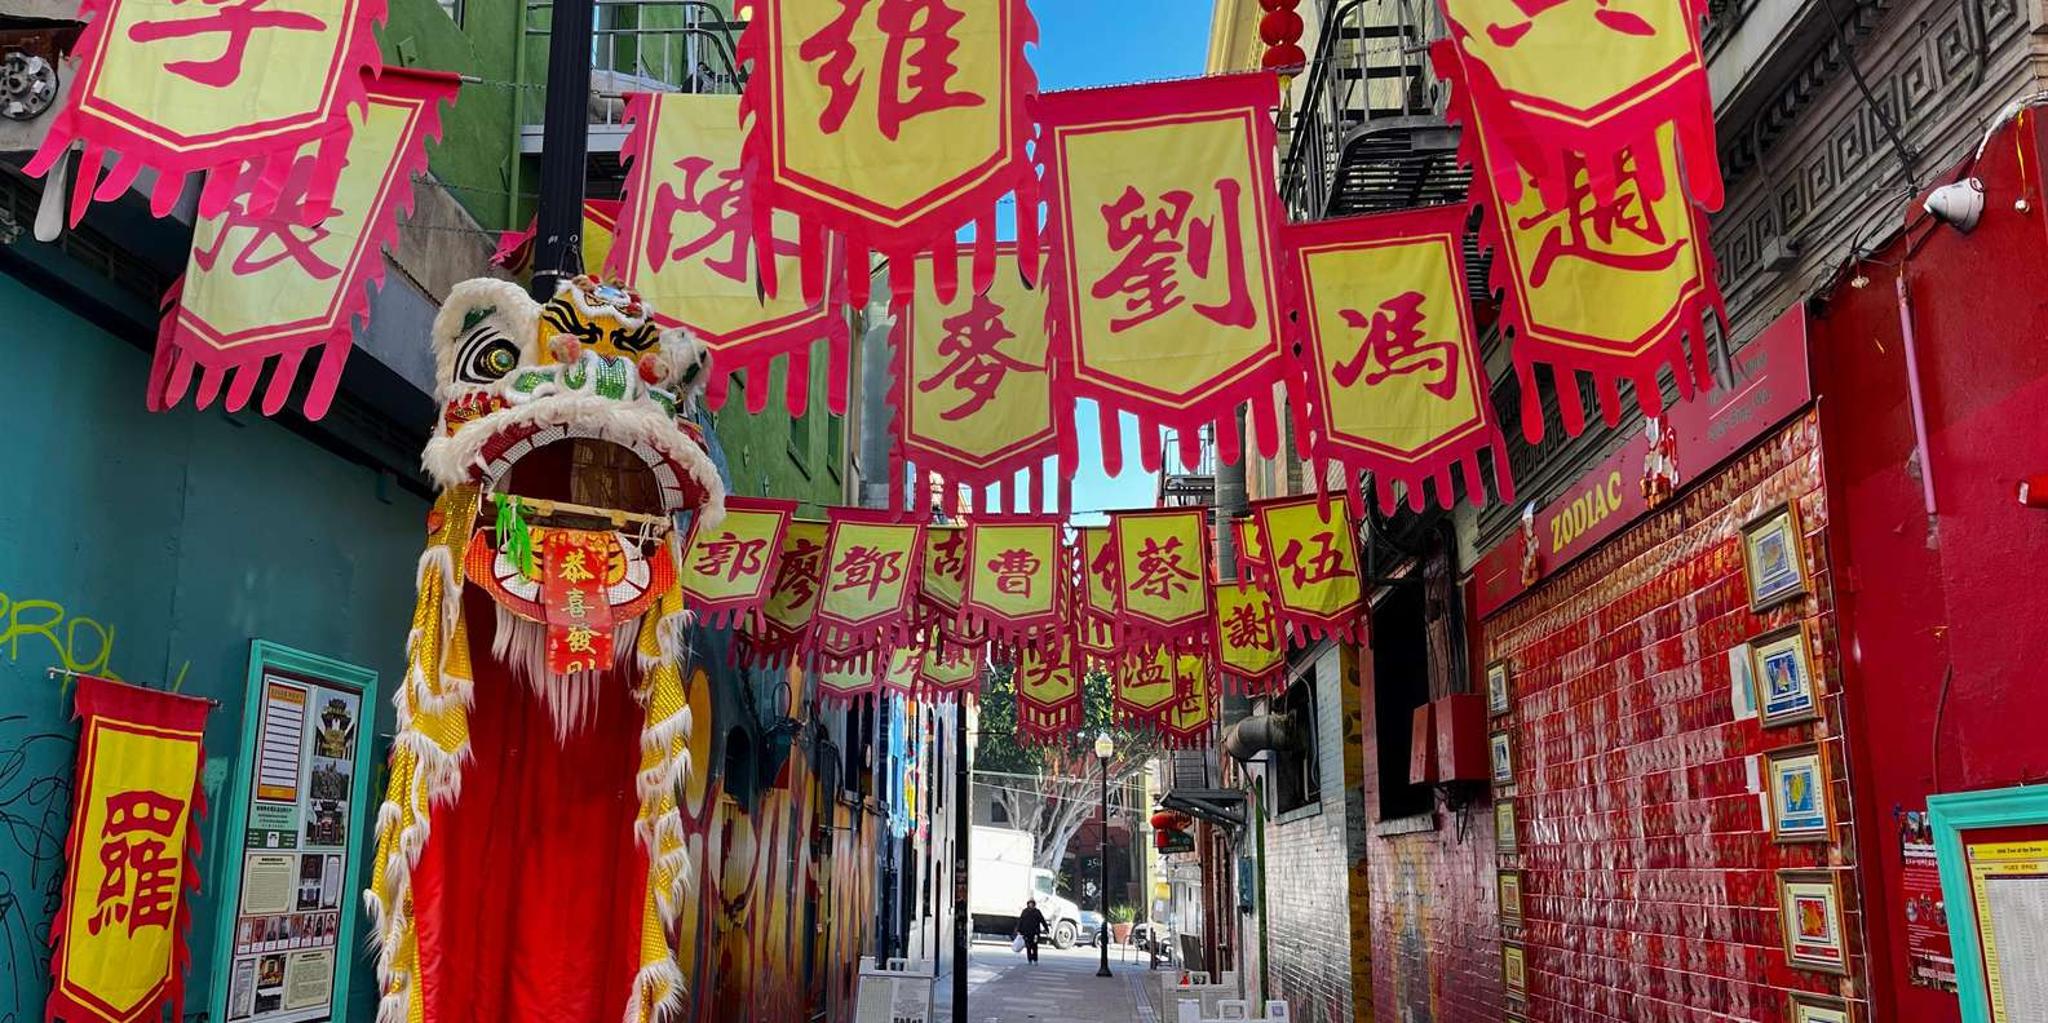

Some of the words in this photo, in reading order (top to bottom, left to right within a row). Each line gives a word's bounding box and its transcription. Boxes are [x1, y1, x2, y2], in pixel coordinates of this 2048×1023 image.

[1090, 177, 1259, 333] 劉
[918, 294, 1047, 422] 麥
[1331, 290, 1460, 401] 馮
[1550, 470, 1623, 554] ZODIAC
[694, 532, 767, 582] 郭
[770, 538, 823, 610] 廖
[833, 545, 904, 602] 鄧
[986, 547, 1042, 600] 曹
[1129, 535, 1201, 600] 蔡
[1277, 531, 1357, 590] 伍
[1223, 601, 1276, 652] 謝
[88, 789, 185, 941] 羅
